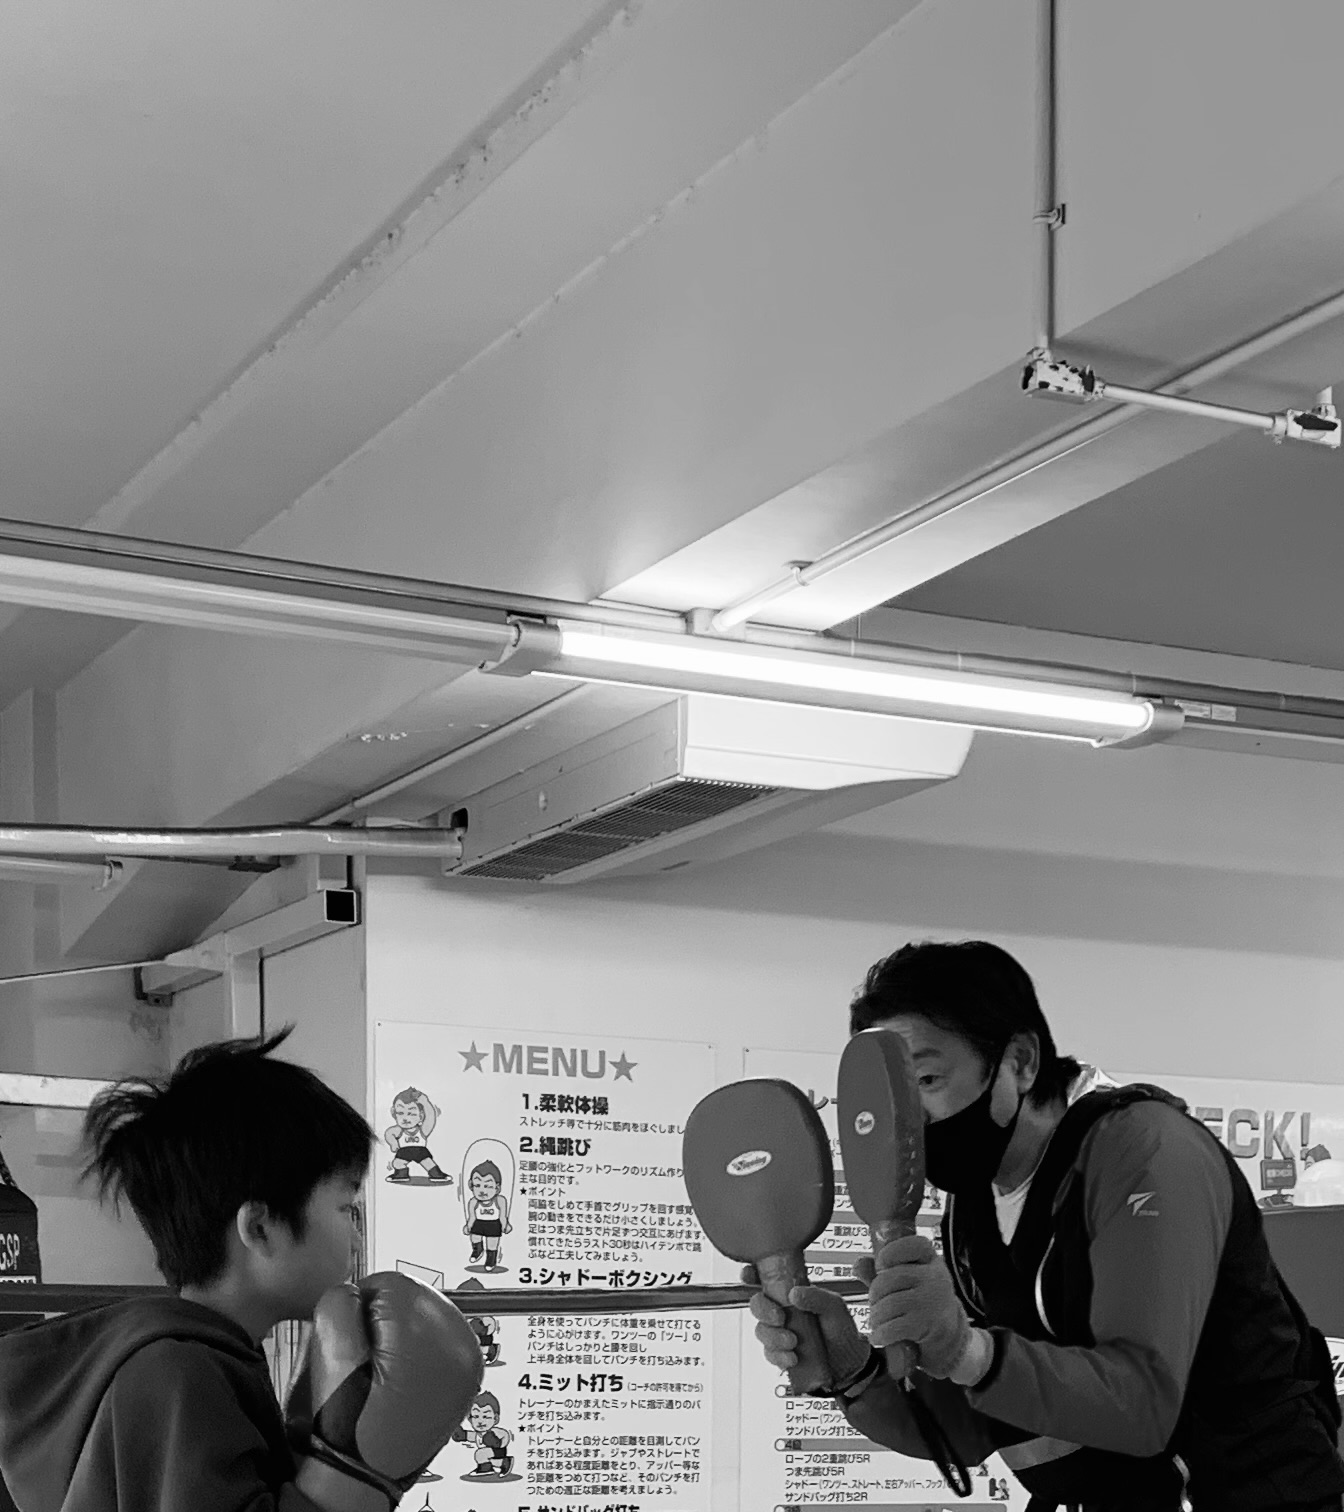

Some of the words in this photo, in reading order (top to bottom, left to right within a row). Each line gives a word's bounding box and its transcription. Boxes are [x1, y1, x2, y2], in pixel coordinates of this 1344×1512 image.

[493, 1043, 606, 1079] MENU
[522, 1093, 609, 1115] 1.柔軟体操
[519, 1136, 591, 1156] 2.縄跳び
[519, 1160, 684, 1177] 足腰の強化とフットワークのリズム作り
[519, 1174, 580, 1186] 主な目的です。
[528, 1187, 566, 1197] ポイント
[528, 1198, 693, 1215] 両脇をしめて手首でグリップを回す感覚
[528, 1211, 697, 1227] 腕の動きをできるだけ小さくしましょう。
[528, 1223, 706, 1240] 足はつま先立ちで片足ずつ交互にあげます。
[528, 1236, 702, 1253] 慣れてきたらラスト30秒はハイテンポで跳
[528, 1249, 643, 1263] ぶなど工夫してみましょう。
[519, 1267, 692, 1287] 3.シャドーボクシング
[527, 1315, 701, 1329] 全身を使ってパンチに体重を乗せて打てる
[527, 1329, 701, 1342] ように心がけます。ワンツーの「ツー」の
[527, 1341, 647, 1353] パンチはしっかりと腰を回し
[527, 1353, 705, 1366] 上半身全体を回してパンチを打ち込みます。
[518, 1374, 623, 1392] 4.ミット打ち
[519, 1399, 701, 1410] トレーナーのかまえたミットに指示通りのパ
[518, 1411, 606, 1422] ンチを打ち込みます。
[527, 1423, 564, 1433] ポイント
[528, 1436, 700, 1447] トレーナーと自分との距離を目測してパン
[527, 1448, 700, 1459] チを打ち込みます。ジャブやストレートで
[785, 1454, 871, 1464] ロープの2重跳び5R
[526, 1460, 700, 1471] あればある程度距離をとり、アッパー等な
[785, 1466, 845, 1477] つま先跳び5R
[527, 1472, 700, 1484] ら距離をつめて打つなど、そのパンチを打
[526, 1485, 678, 1496] つための適正な距離を考えましょう。
[784, 1491, 868, 1502] サンドバッグ打ち2R
